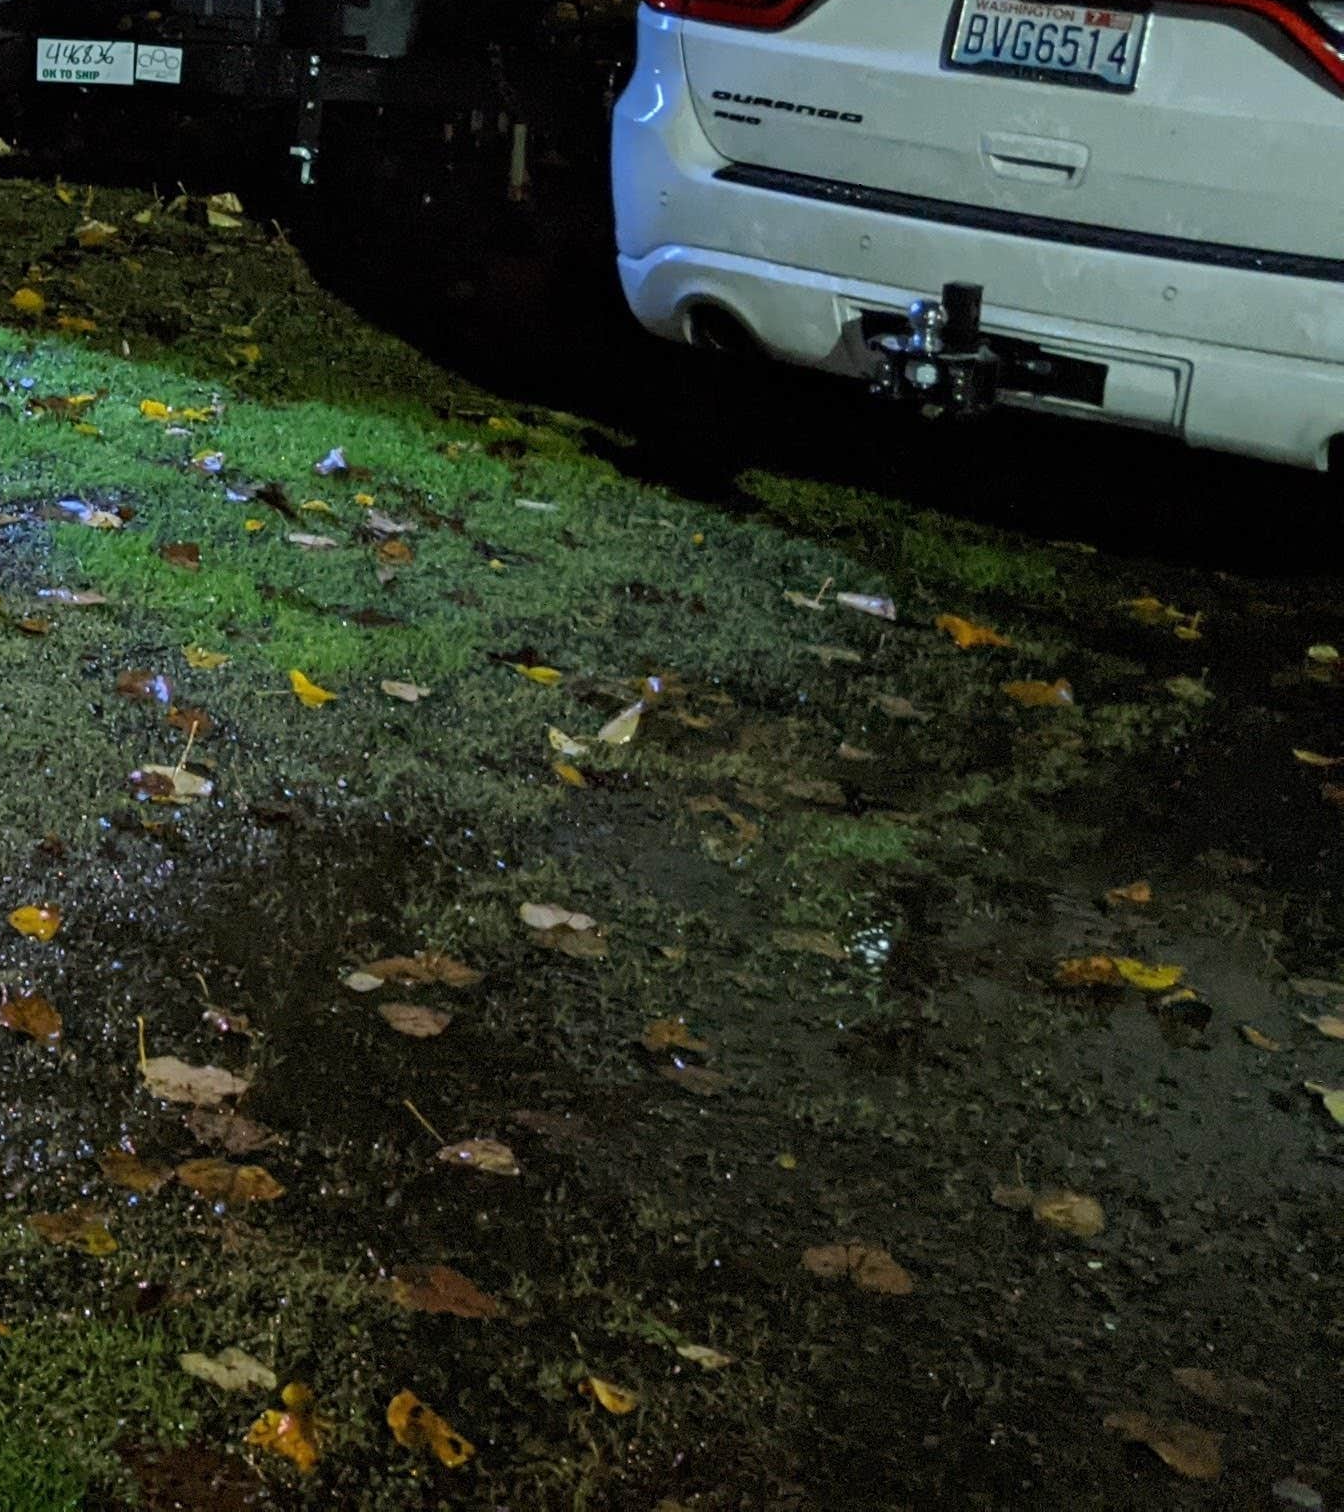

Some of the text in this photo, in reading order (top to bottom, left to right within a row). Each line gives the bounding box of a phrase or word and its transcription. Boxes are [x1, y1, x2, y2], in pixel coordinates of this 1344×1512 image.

[964, 14, 1129, 75] BVG6514
[42, 69, 100, 80] OK TO SHIP
[712, 90, 864, 124] DURANGO
[714, 110, 762, 125] AWD
